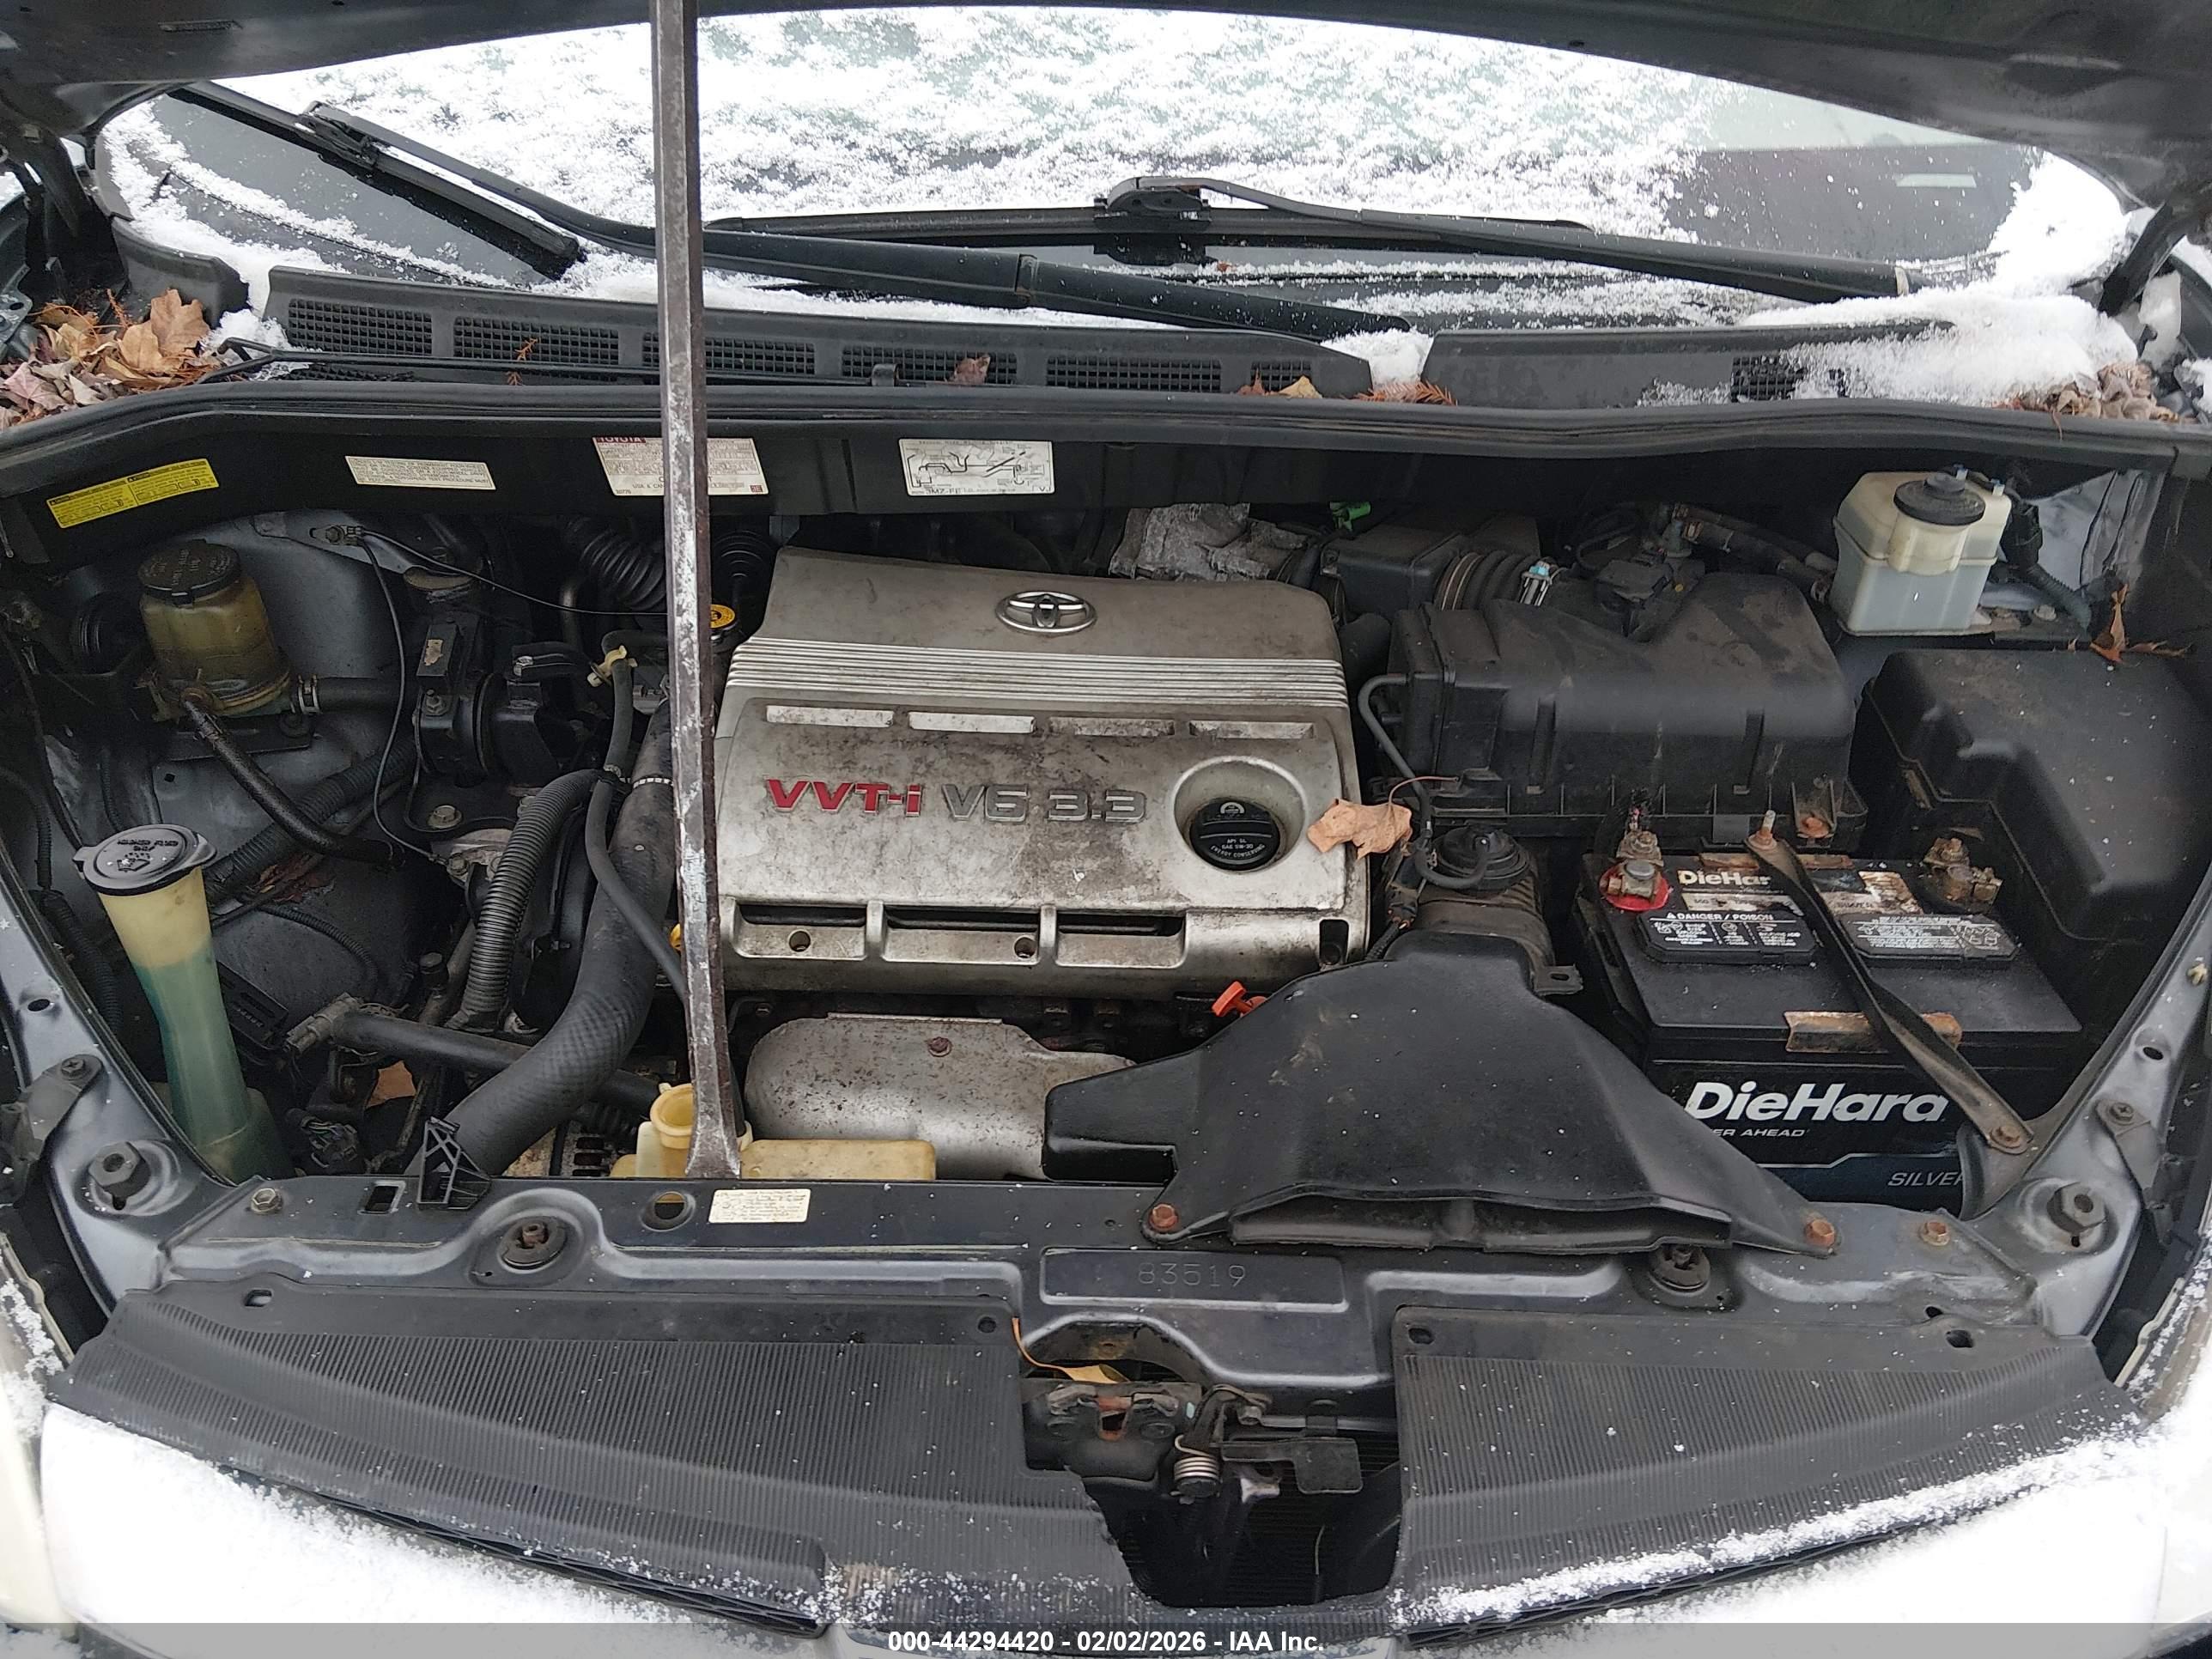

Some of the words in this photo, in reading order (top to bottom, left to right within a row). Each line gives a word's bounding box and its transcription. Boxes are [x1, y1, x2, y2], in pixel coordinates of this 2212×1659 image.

[768, 779, 922, 817] VVT-i
[942, 784, 1028, 822] V6
[1048, 789, 1146, 822] 3.3
[1678, 871, 1771, 885] DieHar
[1740, 1128, 1806, 1138] AHEAD
[1138, 1263, 1245, 1286] 83519
